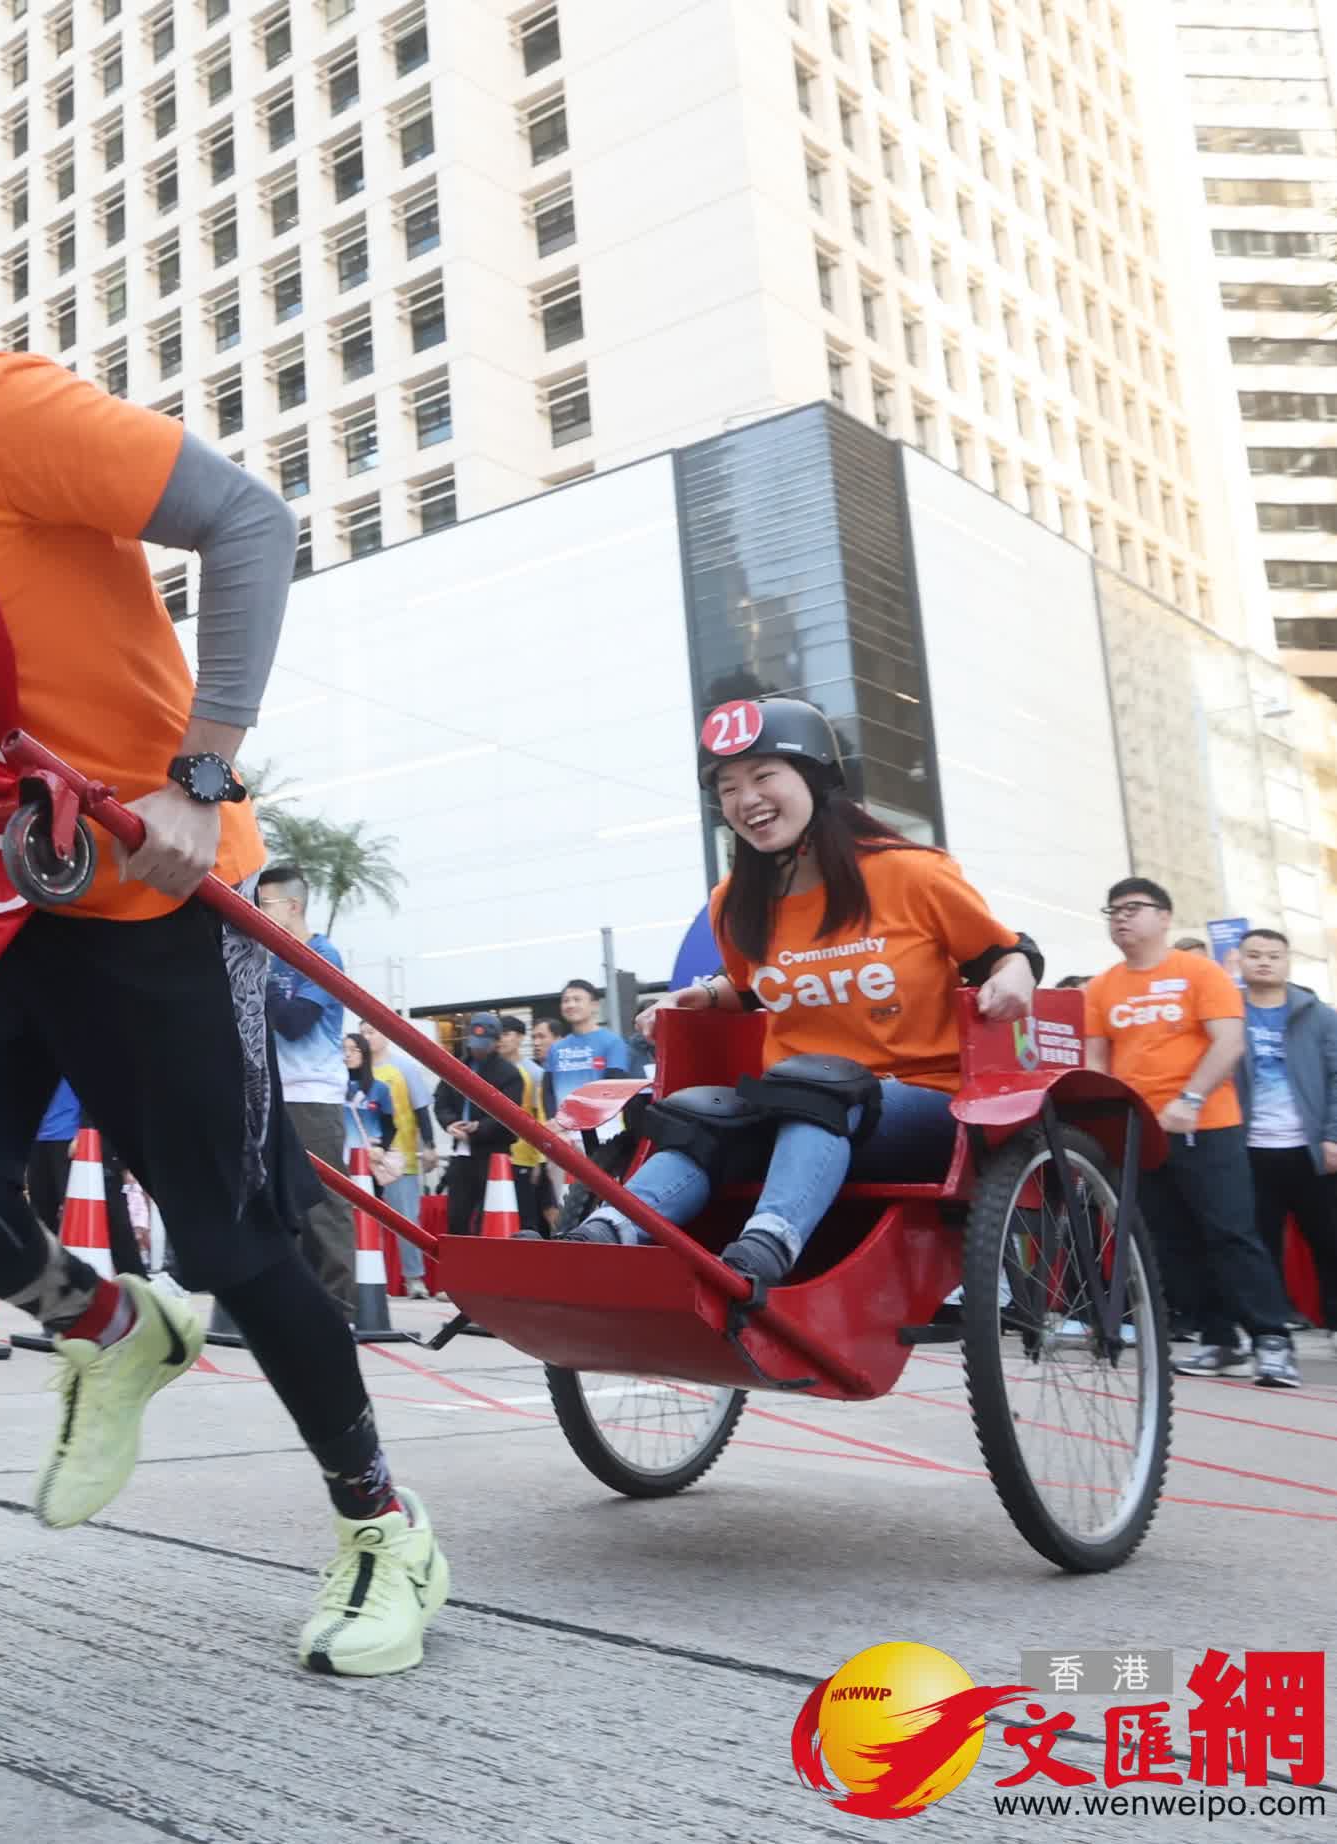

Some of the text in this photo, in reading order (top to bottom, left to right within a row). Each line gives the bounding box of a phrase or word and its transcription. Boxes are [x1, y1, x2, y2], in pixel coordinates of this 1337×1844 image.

[710, 704, 753, 751] 21
[750, 962, 897, 1014] Care
[1109, 1003, 1183, 1029] Care
